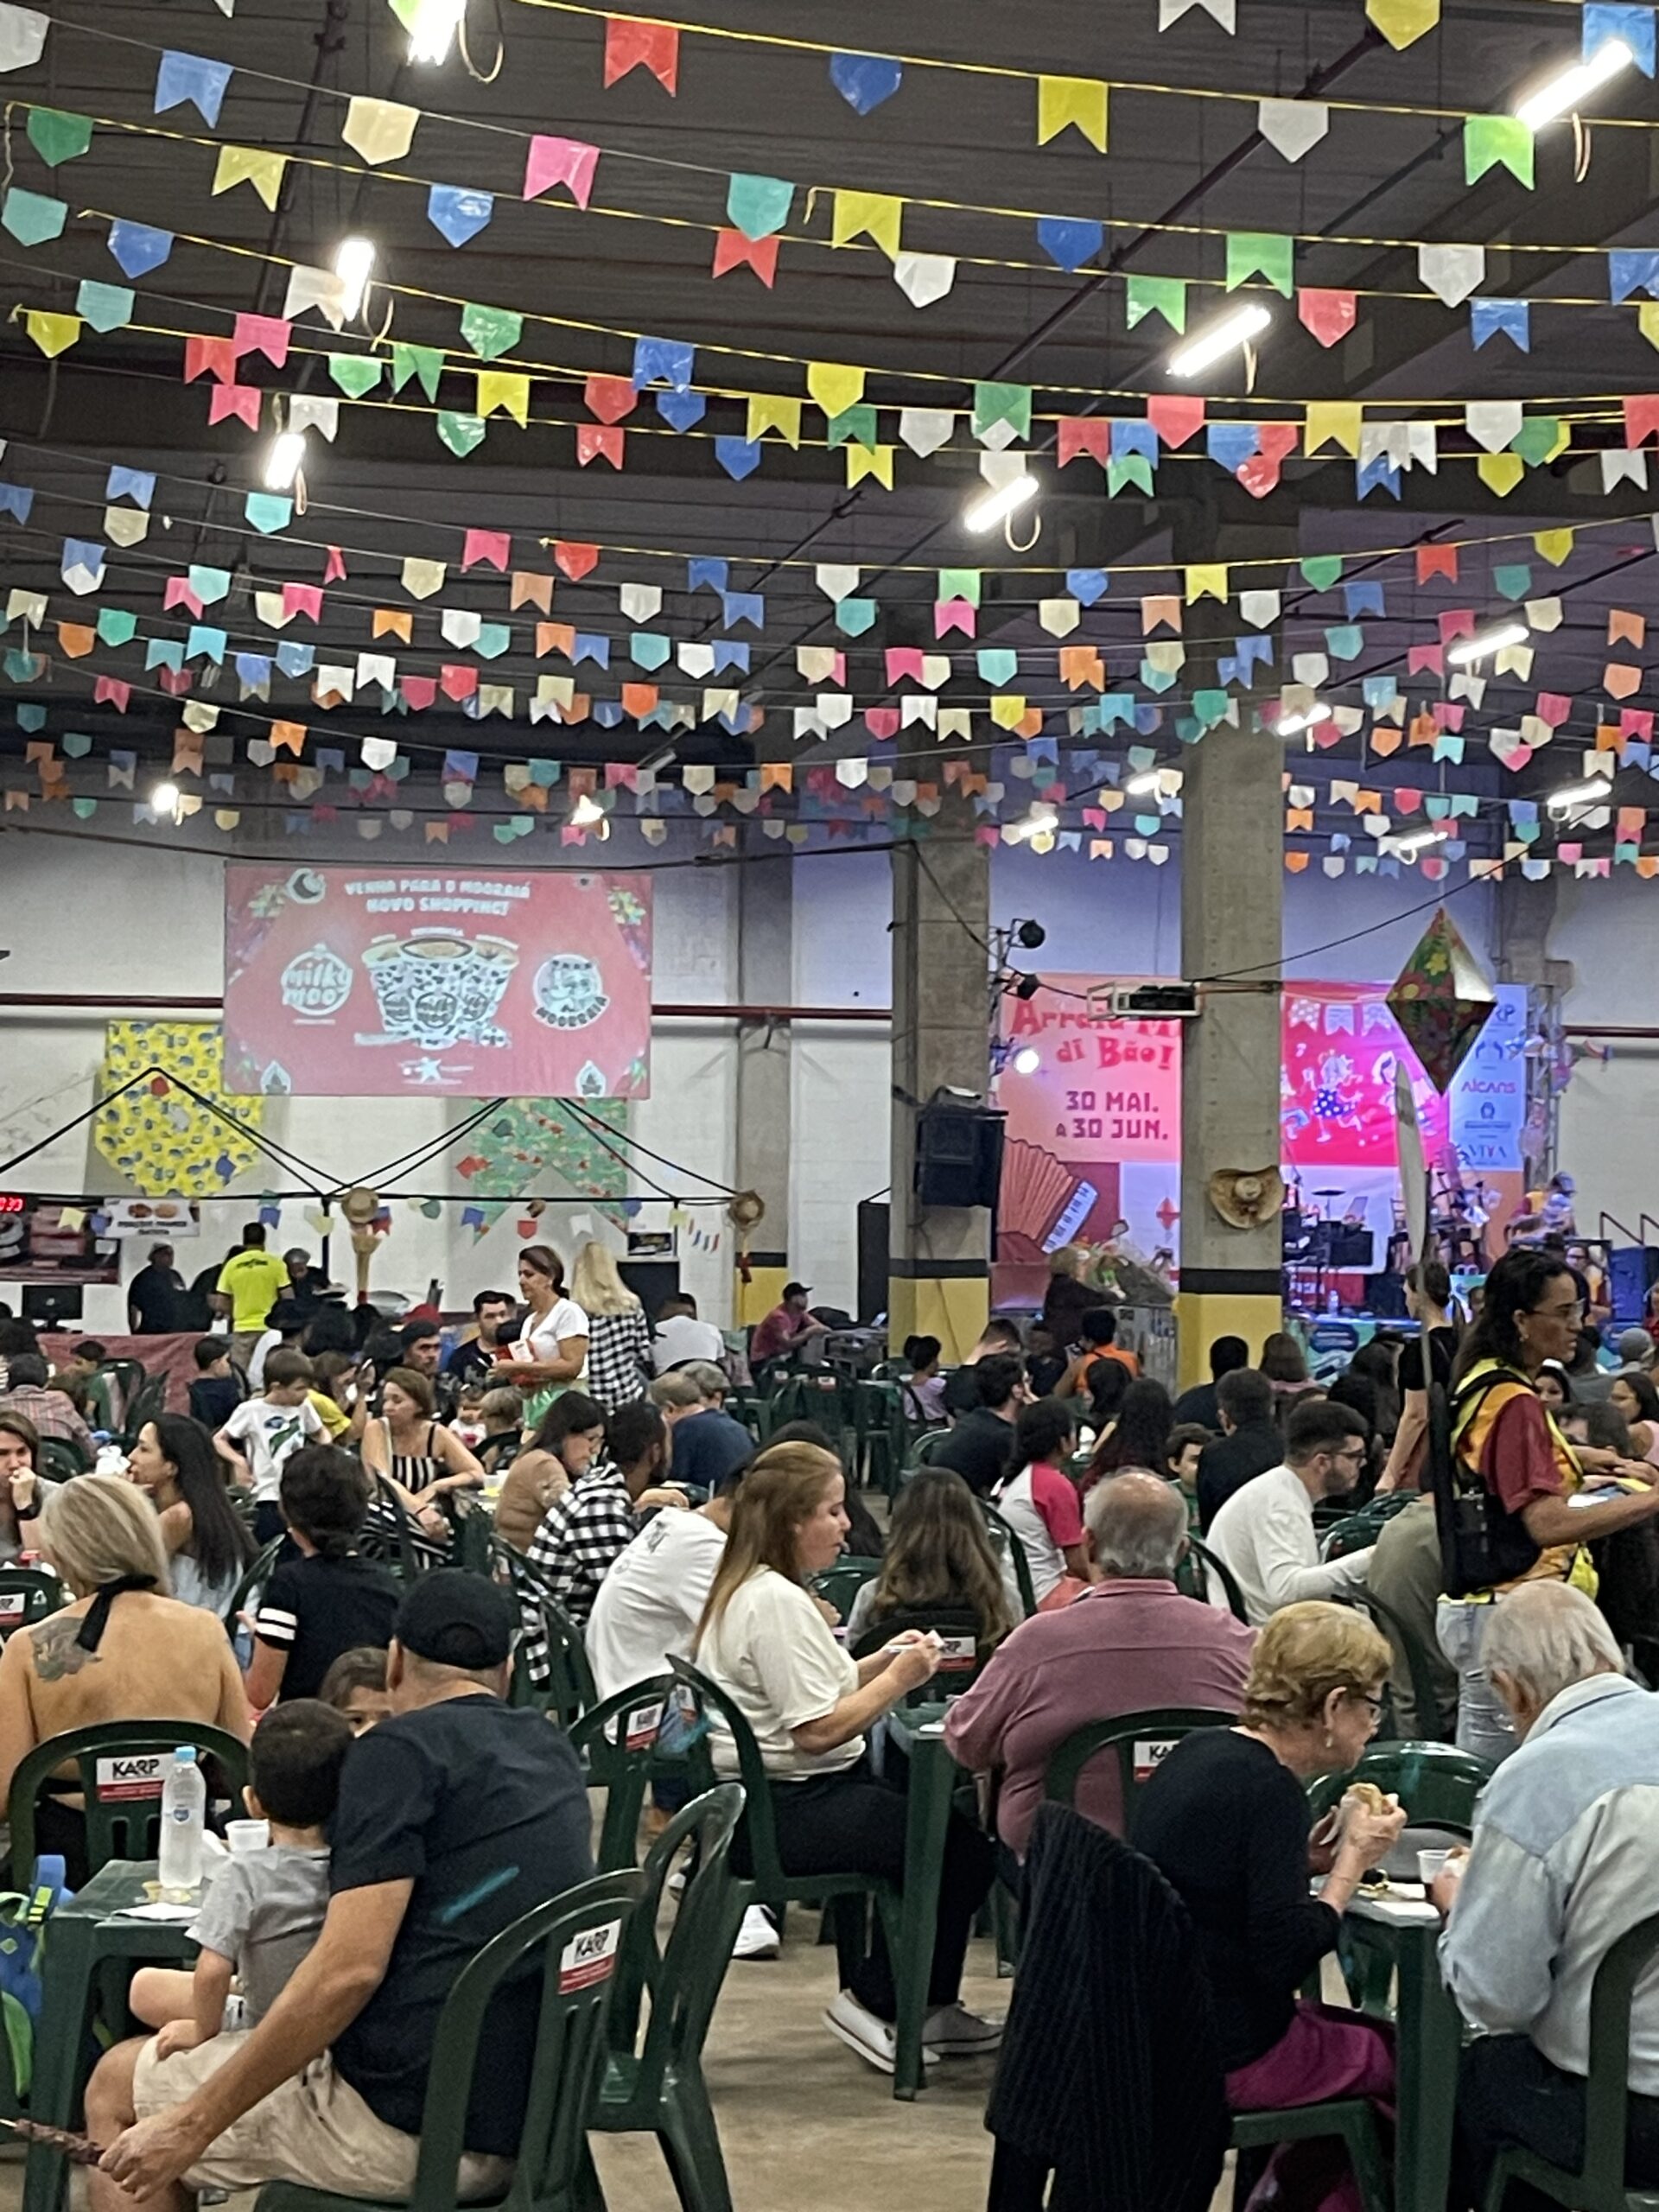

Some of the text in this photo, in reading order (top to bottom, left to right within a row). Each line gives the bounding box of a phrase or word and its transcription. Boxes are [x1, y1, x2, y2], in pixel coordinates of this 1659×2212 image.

[445, 880, 456, 893] O
[284, 957, 351, 986] milky
[283, 979, 338, 1005] moo
[1056, 1036, 1175, 1071] di Bão!
[1065, 1090, 1160, 1113] 30 MAI.
[1056, 1118, 1169, 1140] A 30 JUN.
[112, 1758, 160, 1777] KARP
